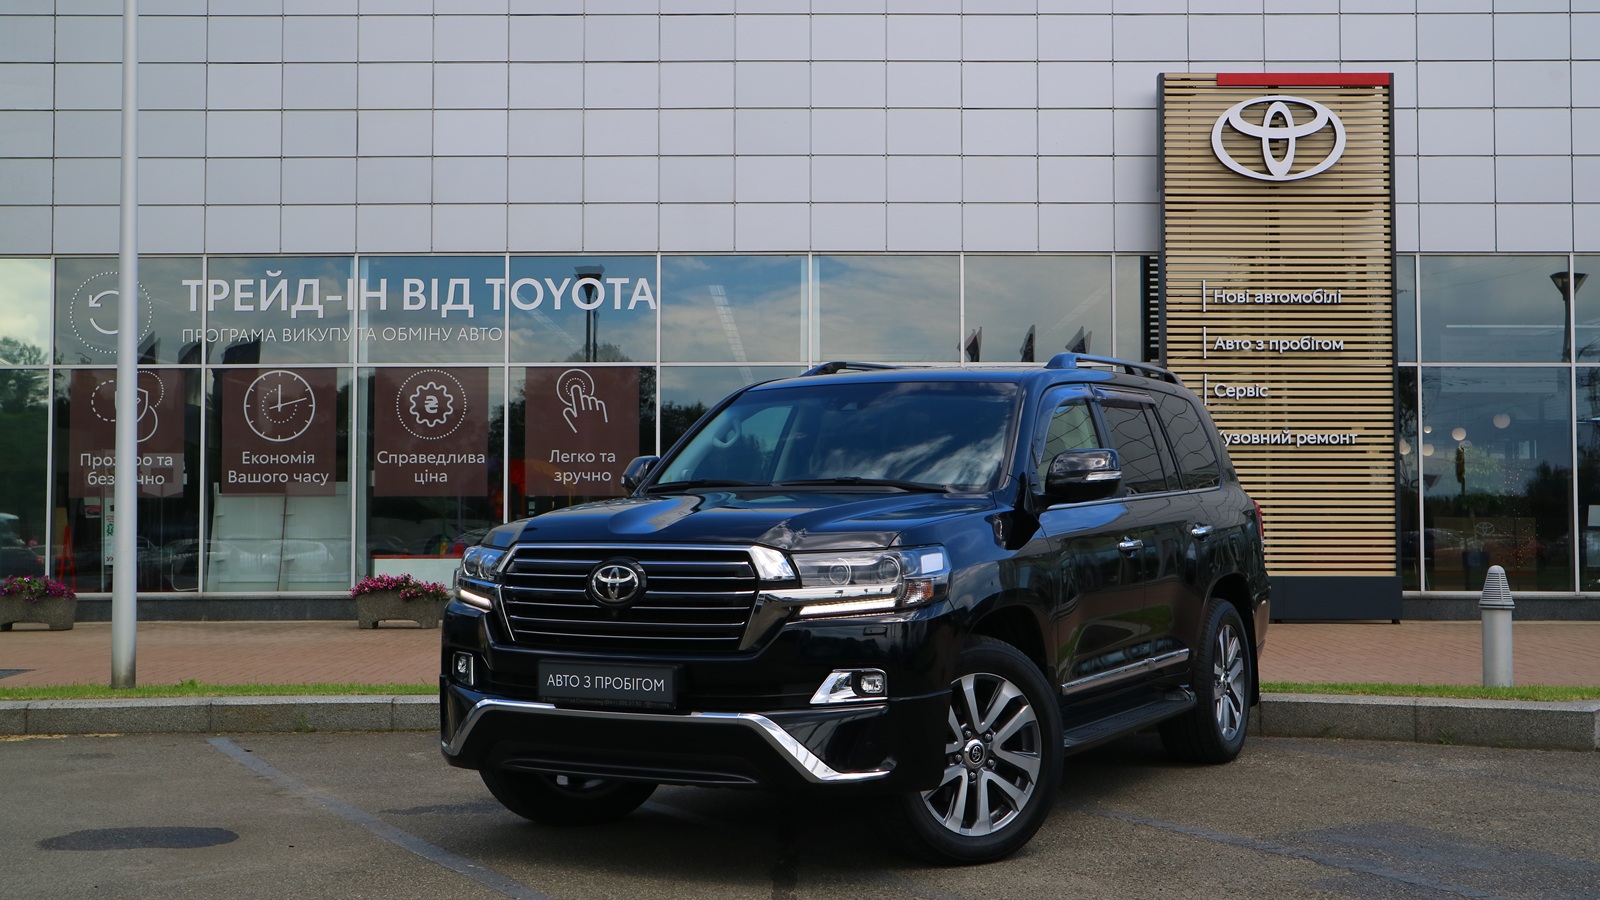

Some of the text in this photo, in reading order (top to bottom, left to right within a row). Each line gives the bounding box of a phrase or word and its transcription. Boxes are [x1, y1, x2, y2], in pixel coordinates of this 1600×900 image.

[182, 270, 657, 319] ТРЕЙД-ІН ВІД TOYOTA
[1213, 288, 1343, 304] Нові автомобілі
[182, 327, 503, 343] ПРОГРАМА ВИКУПУ ТА ОБМІНУ АВТО
[1213, 335, 1345, 354] Авто з пробігом
[1214, 383, 1269, 401] Сервіс
[1296, 432, 1359, 448] ремонт
[156, 455, 173, 467] та
[241, 450, 315, 464] Економія
[376, 450, 486, 467] Справедлива
[548, 449, 616, 464] Легко та
[87, 471, 165, 485] безчно
[228, 470, 330, 486] Вашого часу
[414, 469, 448, 485] ціна
[553, 469, 612, 486] зручно
[546, 673, 580, 688] АВТО
[594, 675, 666, 692] ПРОБІГОМ
